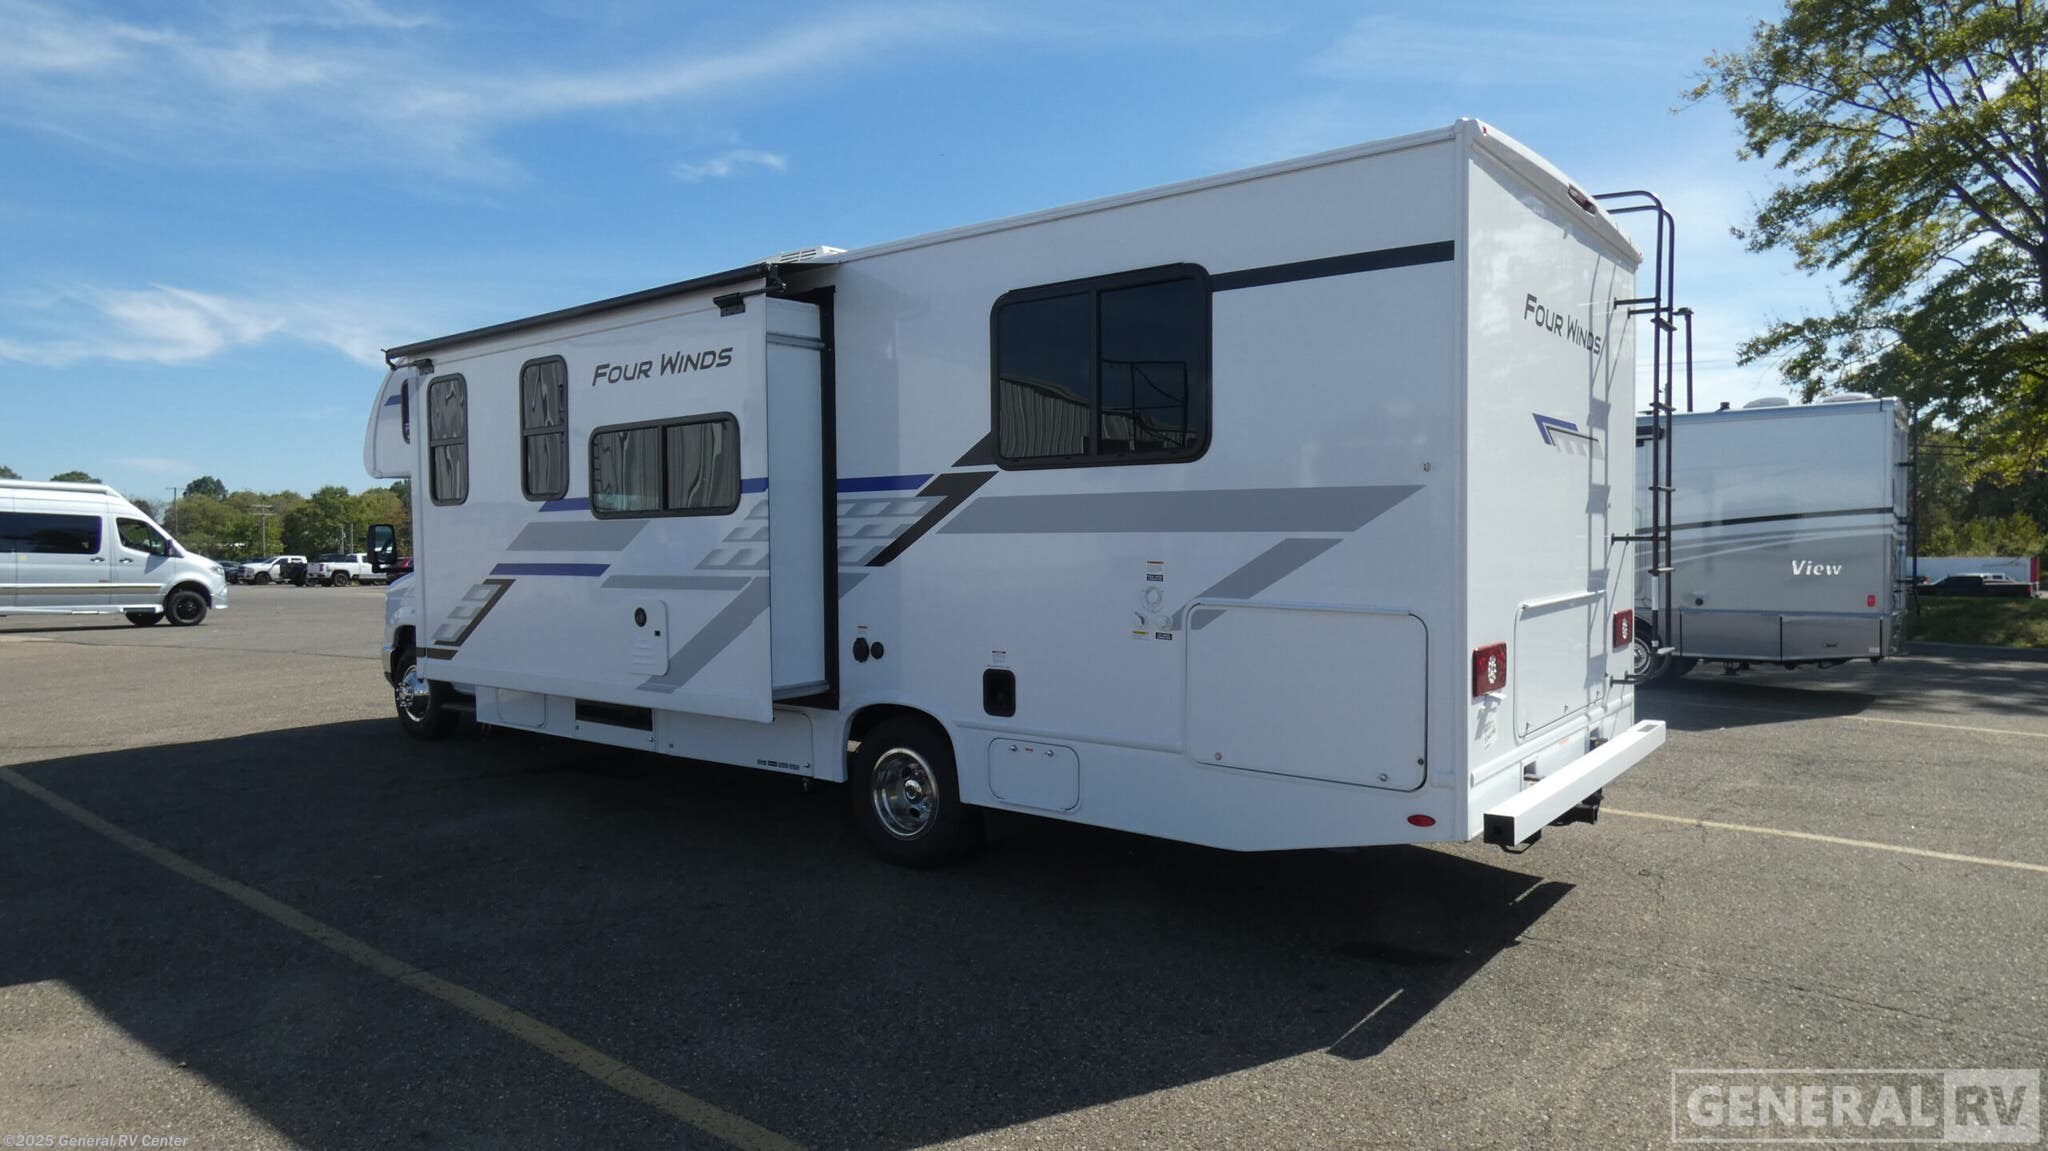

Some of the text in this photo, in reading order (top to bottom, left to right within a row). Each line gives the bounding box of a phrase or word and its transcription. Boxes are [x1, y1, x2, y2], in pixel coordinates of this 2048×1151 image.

[1524, 294, 1601, 356] FOUR WINDS
[592, 347, 733, 387] FOUR WINDS
[1791, 559, 1843, 576] View
